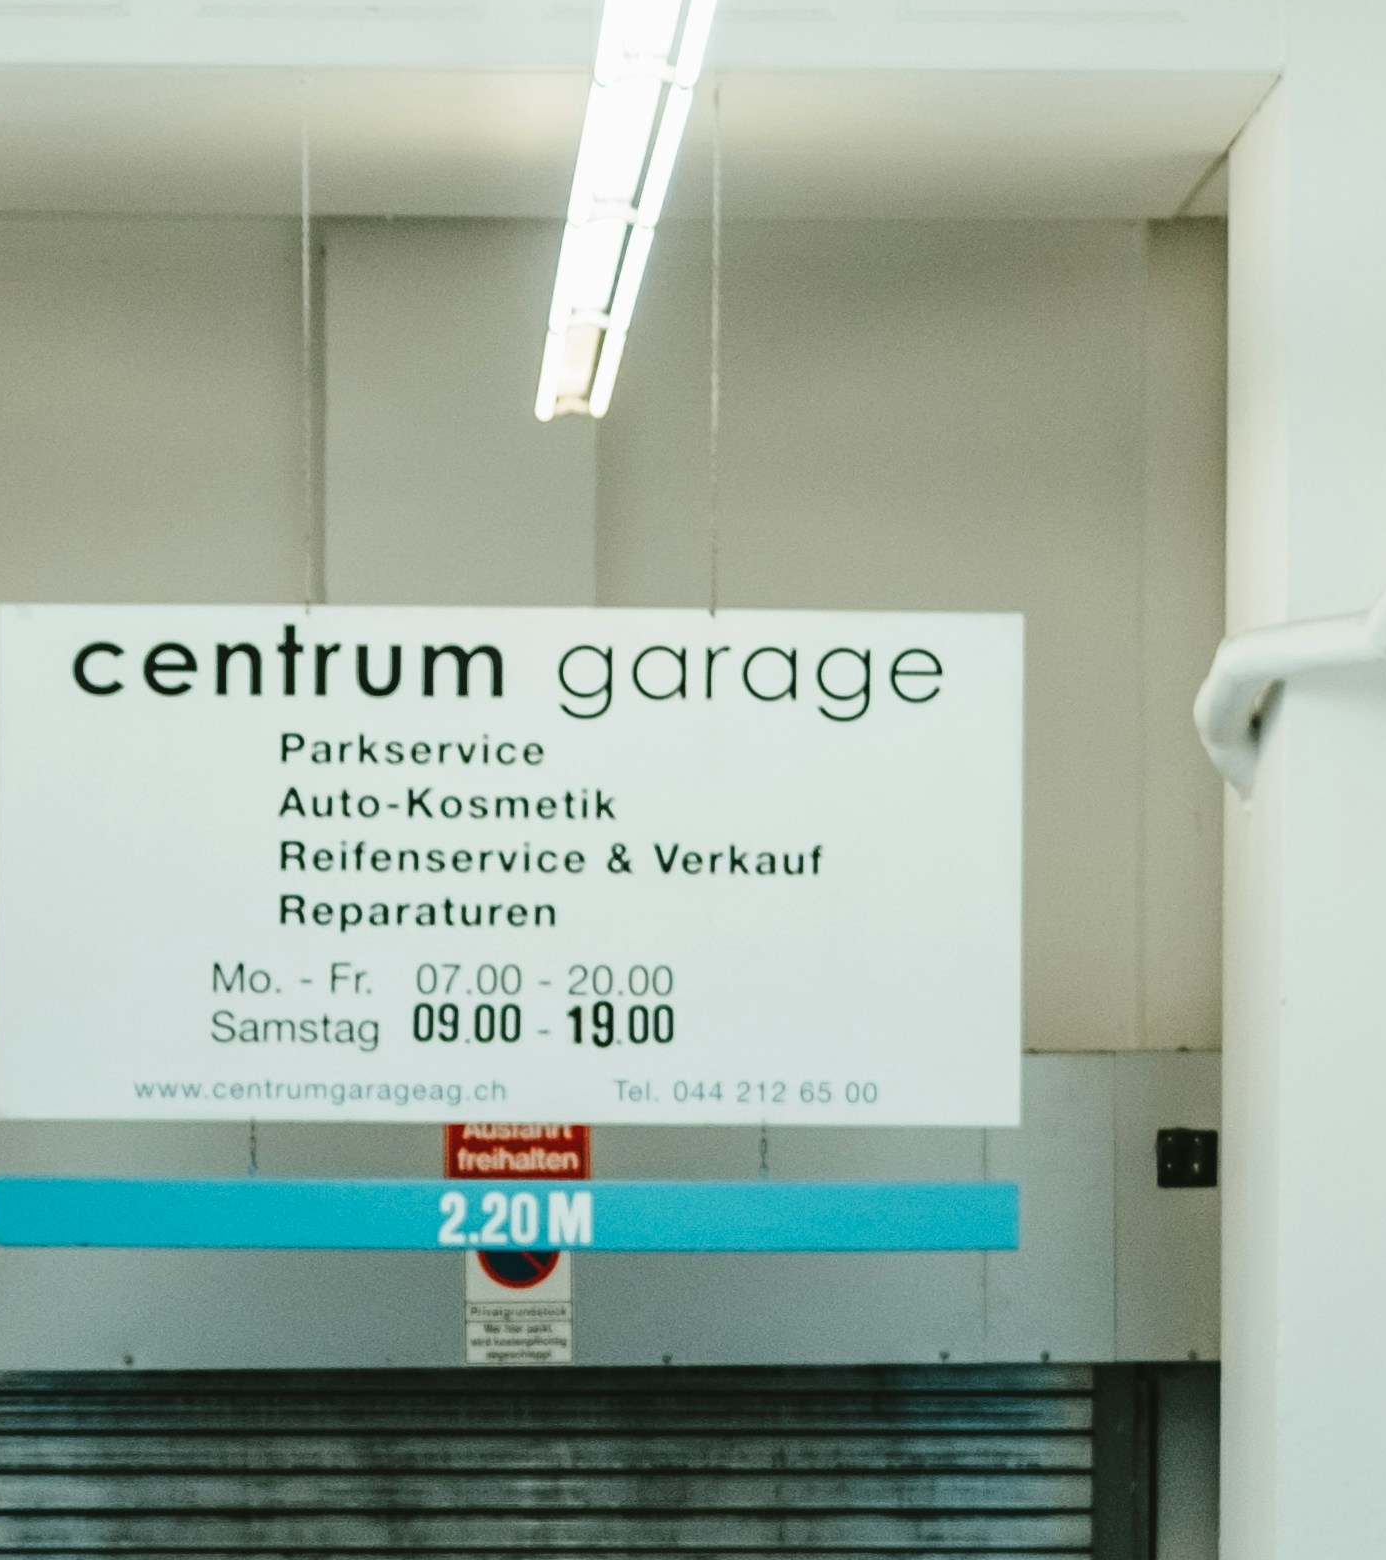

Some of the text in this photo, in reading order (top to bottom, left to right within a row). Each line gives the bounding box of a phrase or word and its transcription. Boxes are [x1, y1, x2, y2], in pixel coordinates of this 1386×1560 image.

[72, 623, 945, 723] centrum garage
[280, 732, 545, 767] Parkservice
[278, 786, 616, 821] Auto-Kosmetik
[279, 840, 824, 877] Reifenservice & Verkauf
[279, 894, 557, 933] Reparaturen
[211, 962, 282, 995] Mo.
[329, 962, 371, 995] Fr.
[416, 962, 522, 996] 07.00
[567, 963, 674, 998] 20.00
[211, 1010, 379, 1051] Samstag
[413, 1003, 522, 1044] 09.00
[567, 1000, 675, 1048] 19.00
[133, 1077, 878, 1106] www.centrumgarageag.ch Tel. 044 212 65 00
[457, 1146, 580, 1172] freihalten
[438, 1190, 595, 1246] 2.20 M
